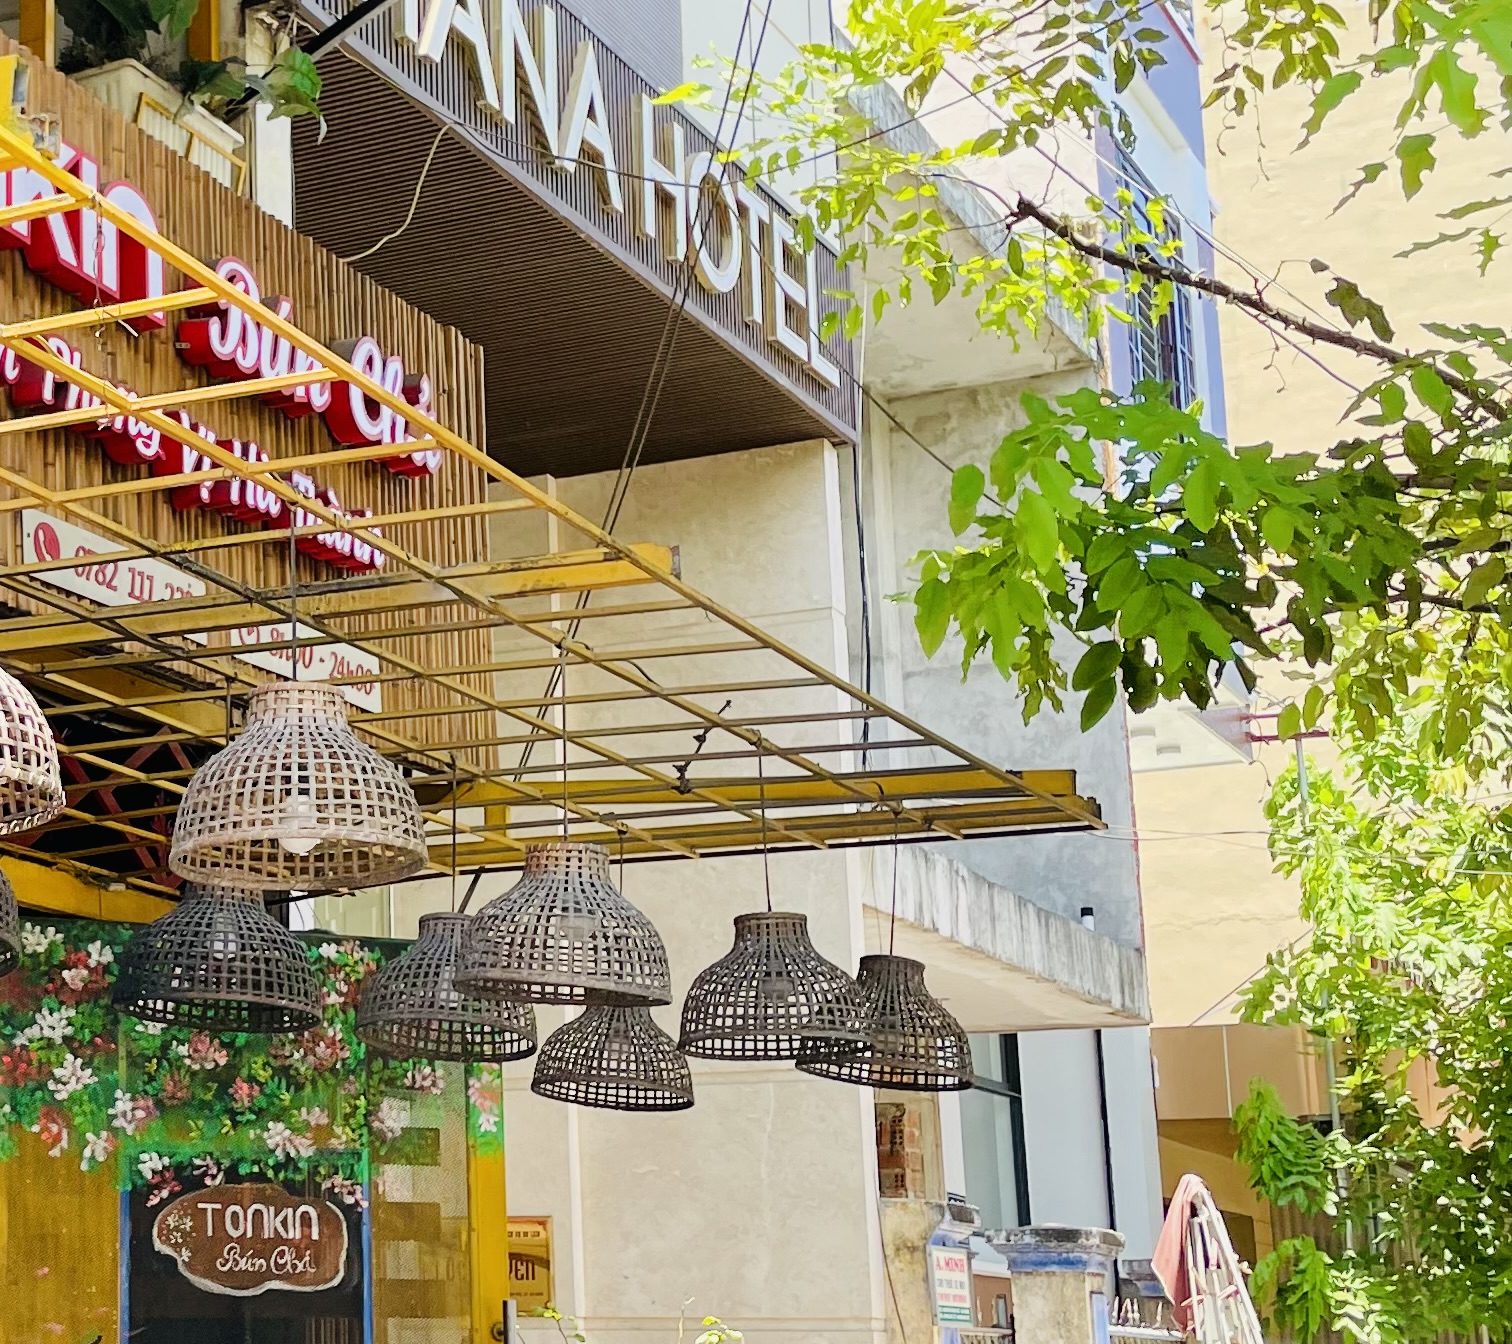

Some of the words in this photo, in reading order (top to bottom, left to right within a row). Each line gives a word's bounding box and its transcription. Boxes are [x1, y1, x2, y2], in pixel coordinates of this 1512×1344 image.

[633, 92, 841, 390] HOTEL
[205, 256, 332, 413] Bún
[348, 336, 444, 475] Chả
[74, 545, 120, 593] 0782
[128, 567, 155, 603] 111
[196, 1202, 320, 1241] TONKIN
[215, 1242, 267, 1273] Bún
